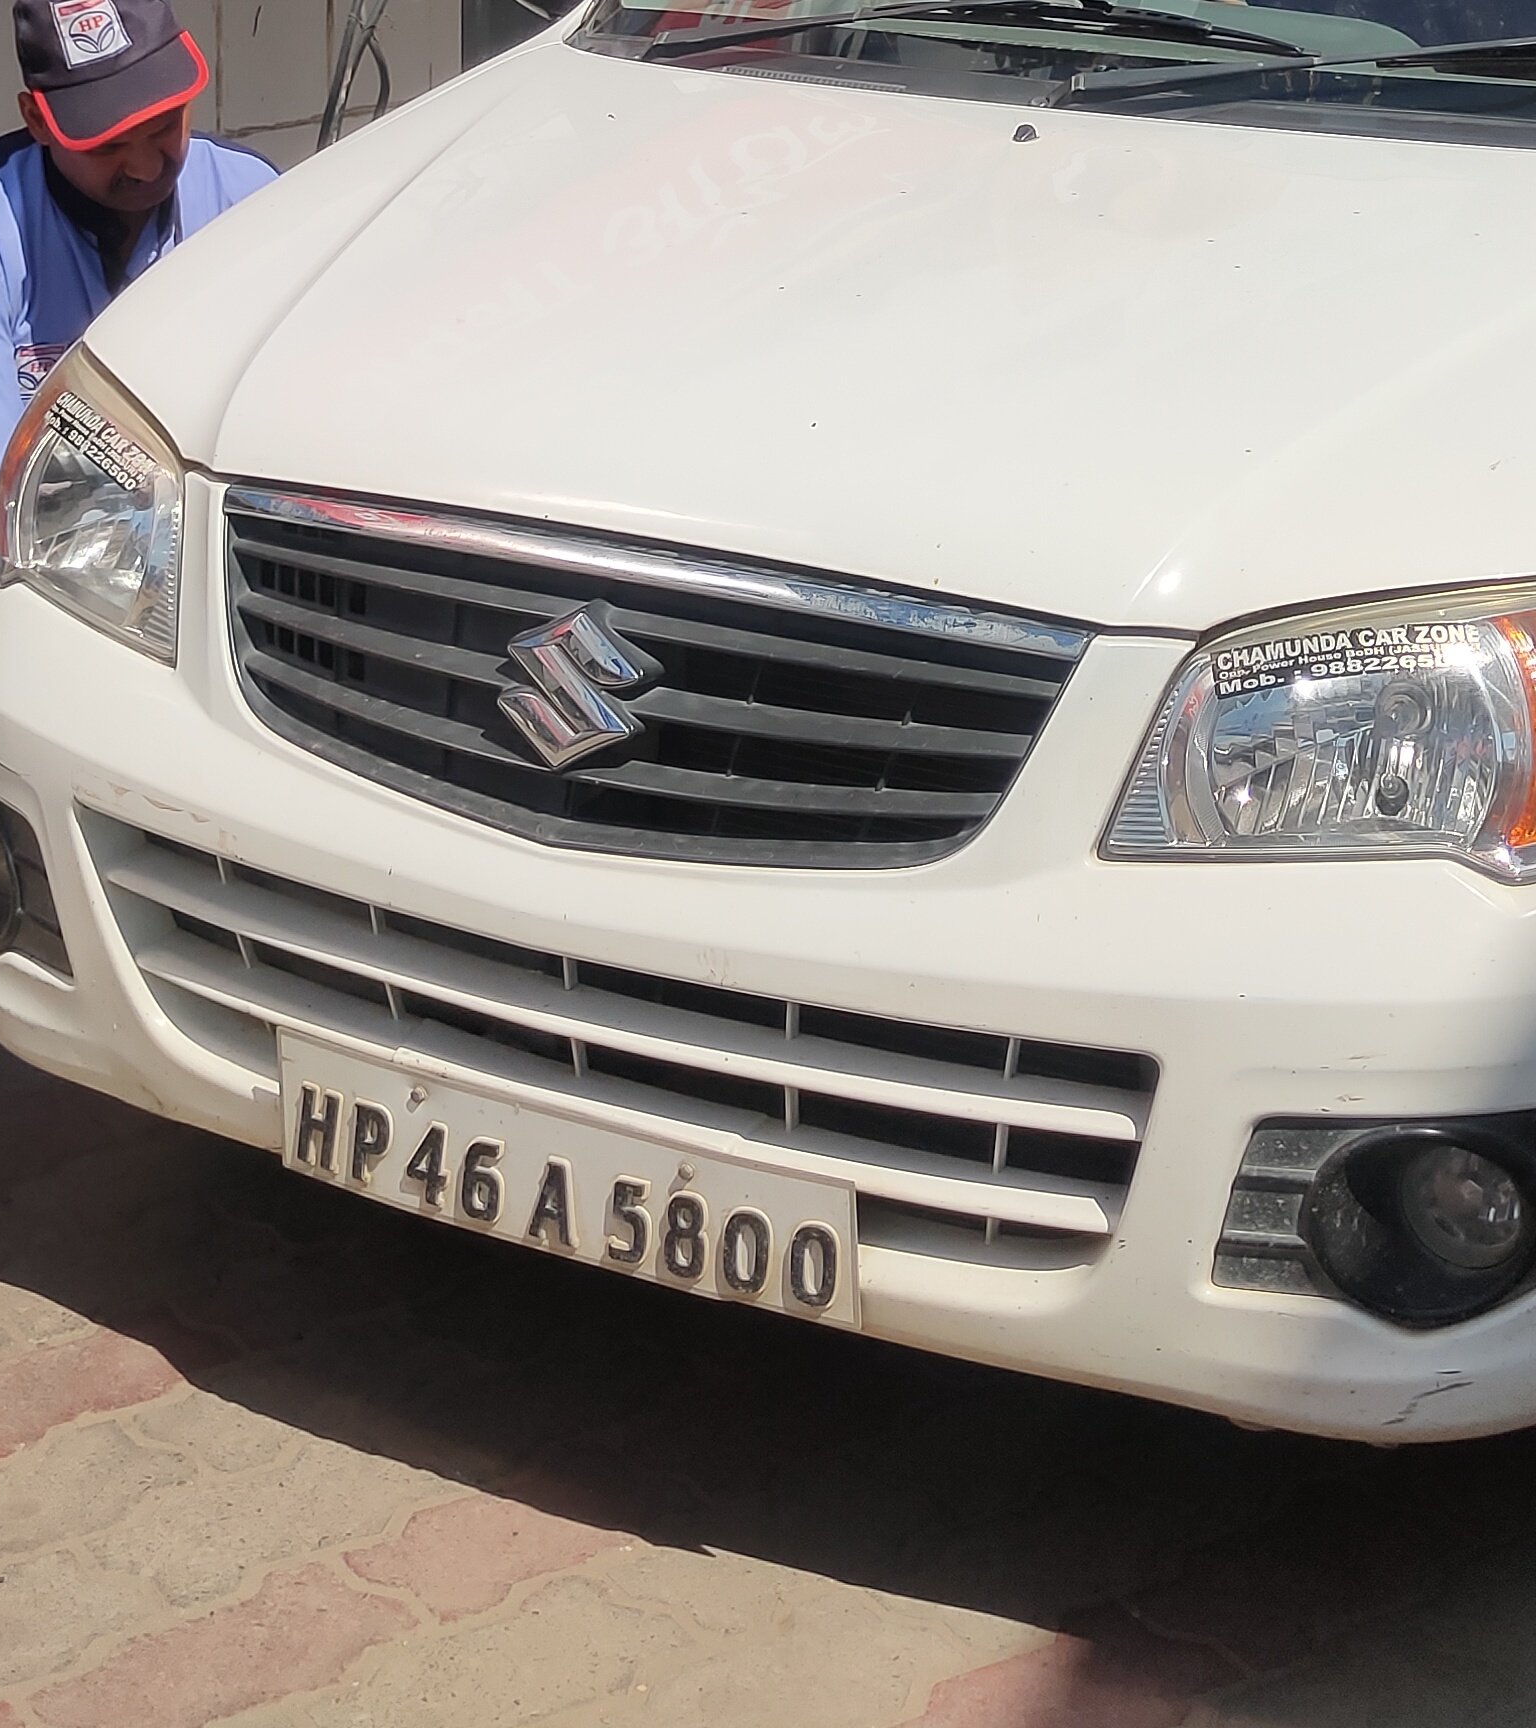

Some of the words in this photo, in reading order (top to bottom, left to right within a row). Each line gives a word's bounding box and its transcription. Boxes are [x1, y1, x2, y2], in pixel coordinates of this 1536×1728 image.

[78, 14, 104, 32] HP
[56, 391, 108, 436] CHAMUNDA
[101, 426, 131, 454] CAR
[1217, 632, 1353, 671] CHAMUNDA
[1358, 627, 1411, 647] CAR
[1413, 623, 1480, 644] ZONE
[1252, 658, 1296, 673] Power
[1298, 651, 1342, 665] House
[1219, 673, 1285, 695] Mob.
[297, 1078, 395, 1185] HP
[406, 1120, 507, 1226] 46
[528, 1154, 580, 1251] A
[607, 1174, 838, 1311] 5800
